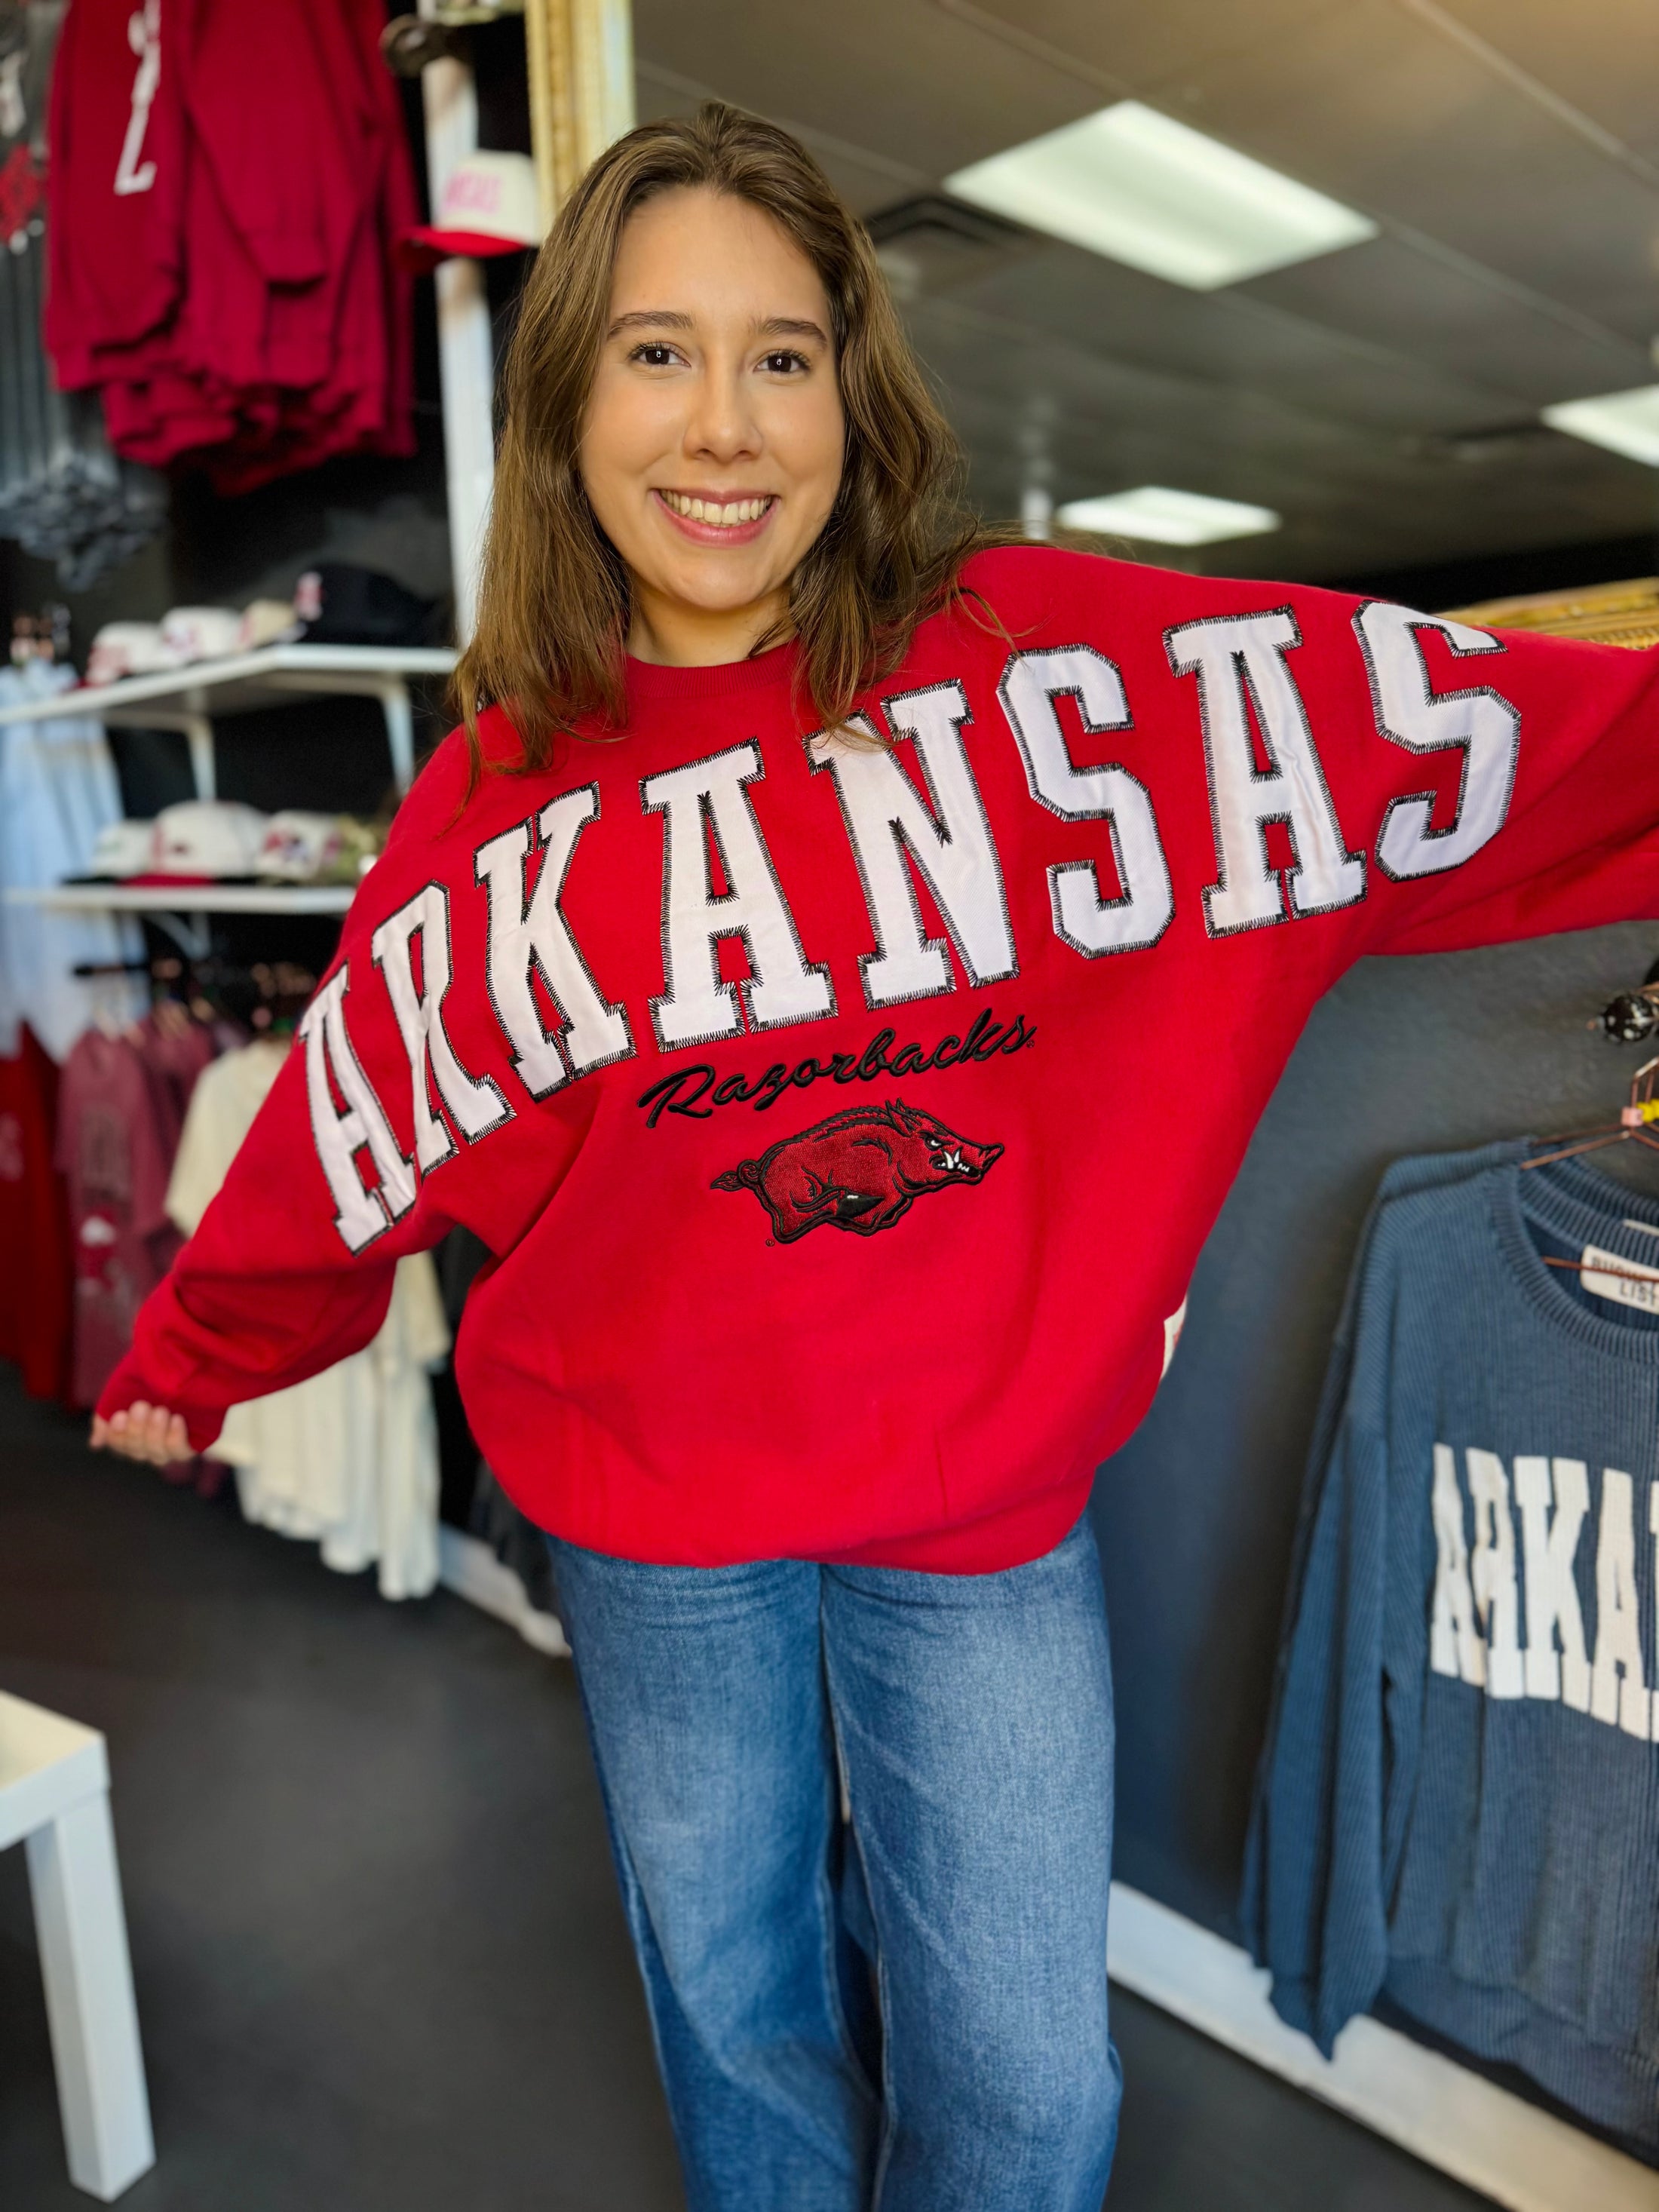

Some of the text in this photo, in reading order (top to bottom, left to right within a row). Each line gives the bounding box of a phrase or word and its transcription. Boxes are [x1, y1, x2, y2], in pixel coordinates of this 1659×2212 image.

[299, 599, 1522, 1257] ARKANSAS
[636, 1008, 1038, 1128] Razorbacks
[1431, 1441, 1659, 1743] ARKA
